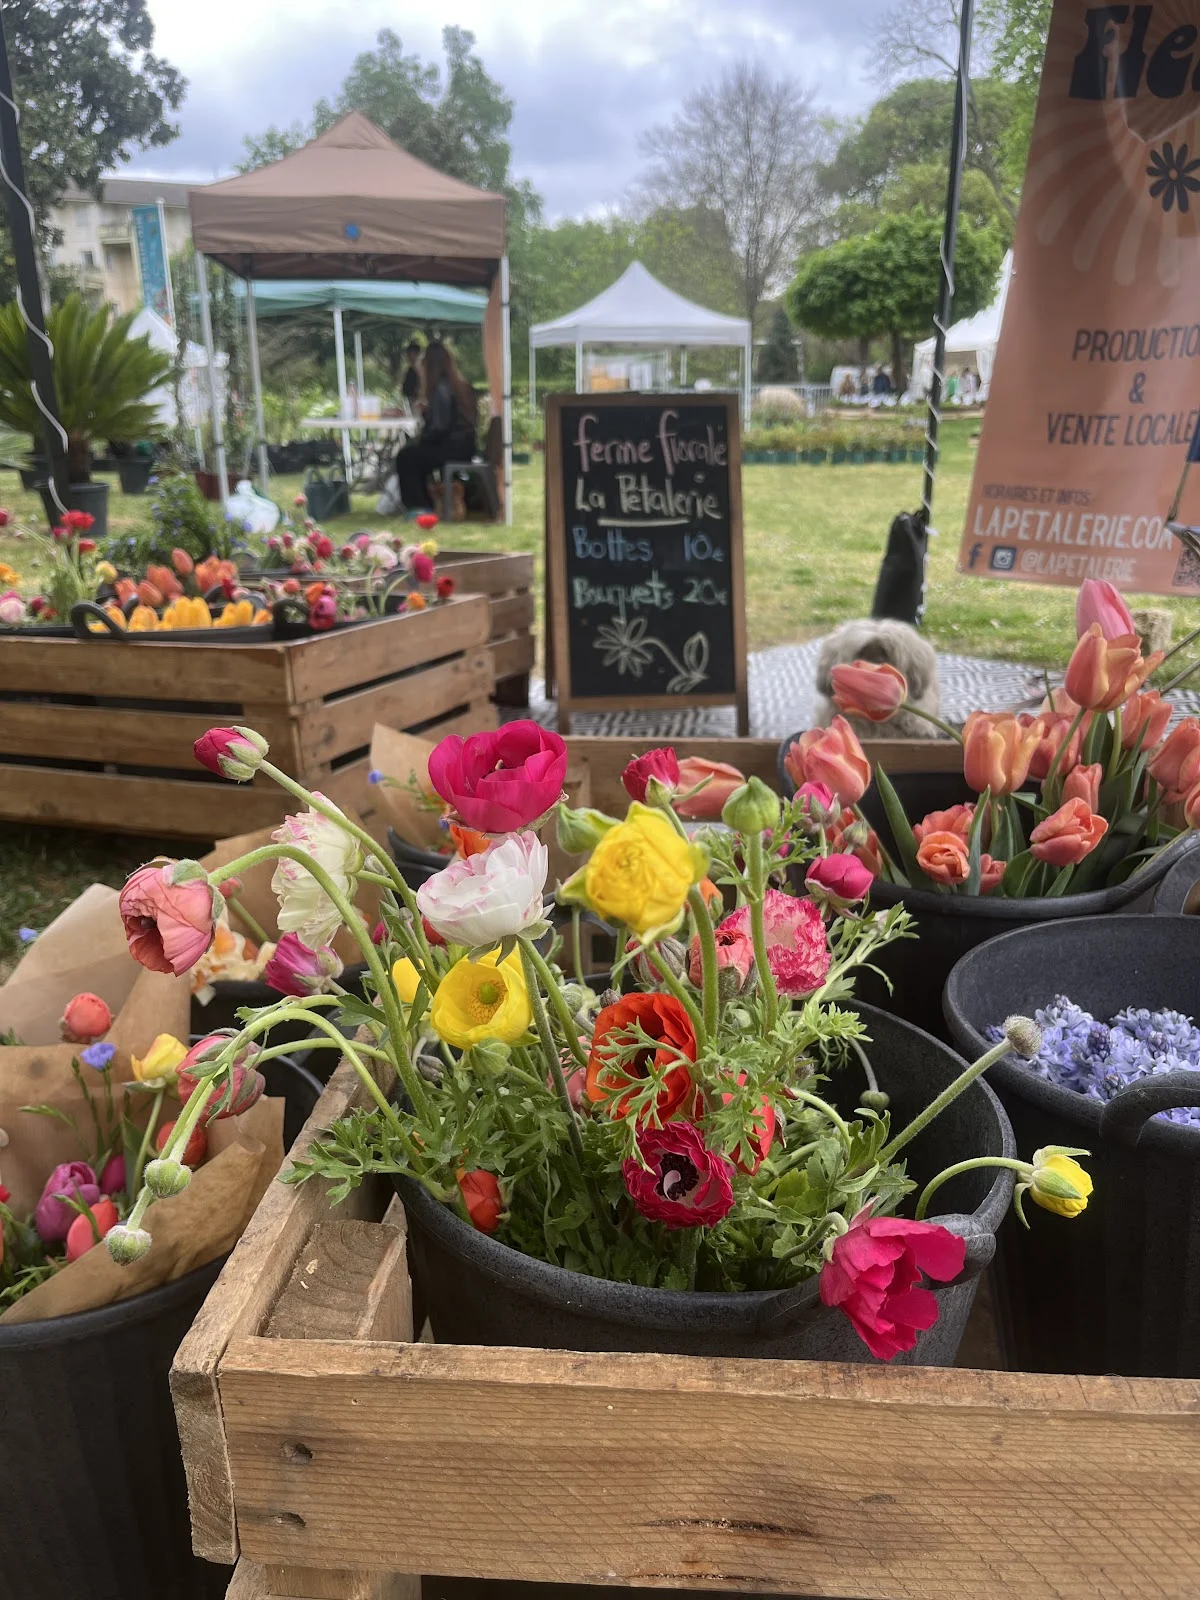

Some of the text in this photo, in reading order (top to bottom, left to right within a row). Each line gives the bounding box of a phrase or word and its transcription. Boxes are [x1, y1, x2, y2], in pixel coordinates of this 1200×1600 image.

[1069, 5, 1200, 99] Fle
[1128, 371, 1146, 404] &
[573, 409, 728, 475] ferme florale
[1047, 408, 1199, 446] VENTE LOCALE
[575, 475, 606, 512] La
[572, 525, 653, 562] Bottes
[973, 504, 1173, 550] LAPETALERIE.COM
[573, 568, 675, 617] Bouquets
